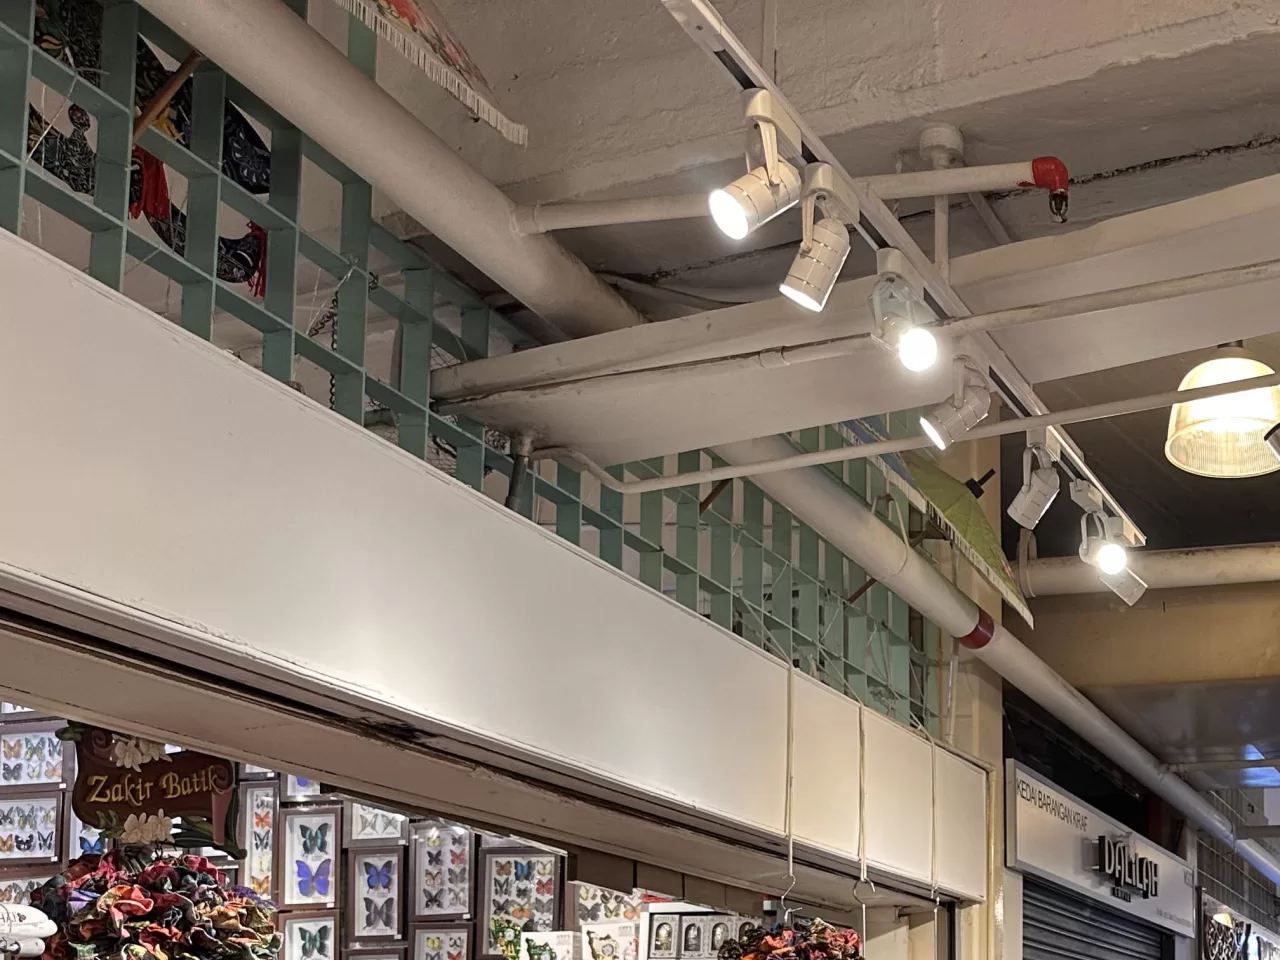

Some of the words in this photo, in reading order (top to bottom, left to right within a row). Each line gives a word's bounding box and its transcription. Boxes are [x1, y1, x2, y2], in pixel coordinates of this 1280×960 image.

[86, 773, 154, 806] Zakir
[159, 765, 224, 800] Batik
[1016, 777, 1038, 806] KEDAI
[1037, 789, 1074, 826] BARANGAN
[1072, 809, 1088, 832] KRAF
